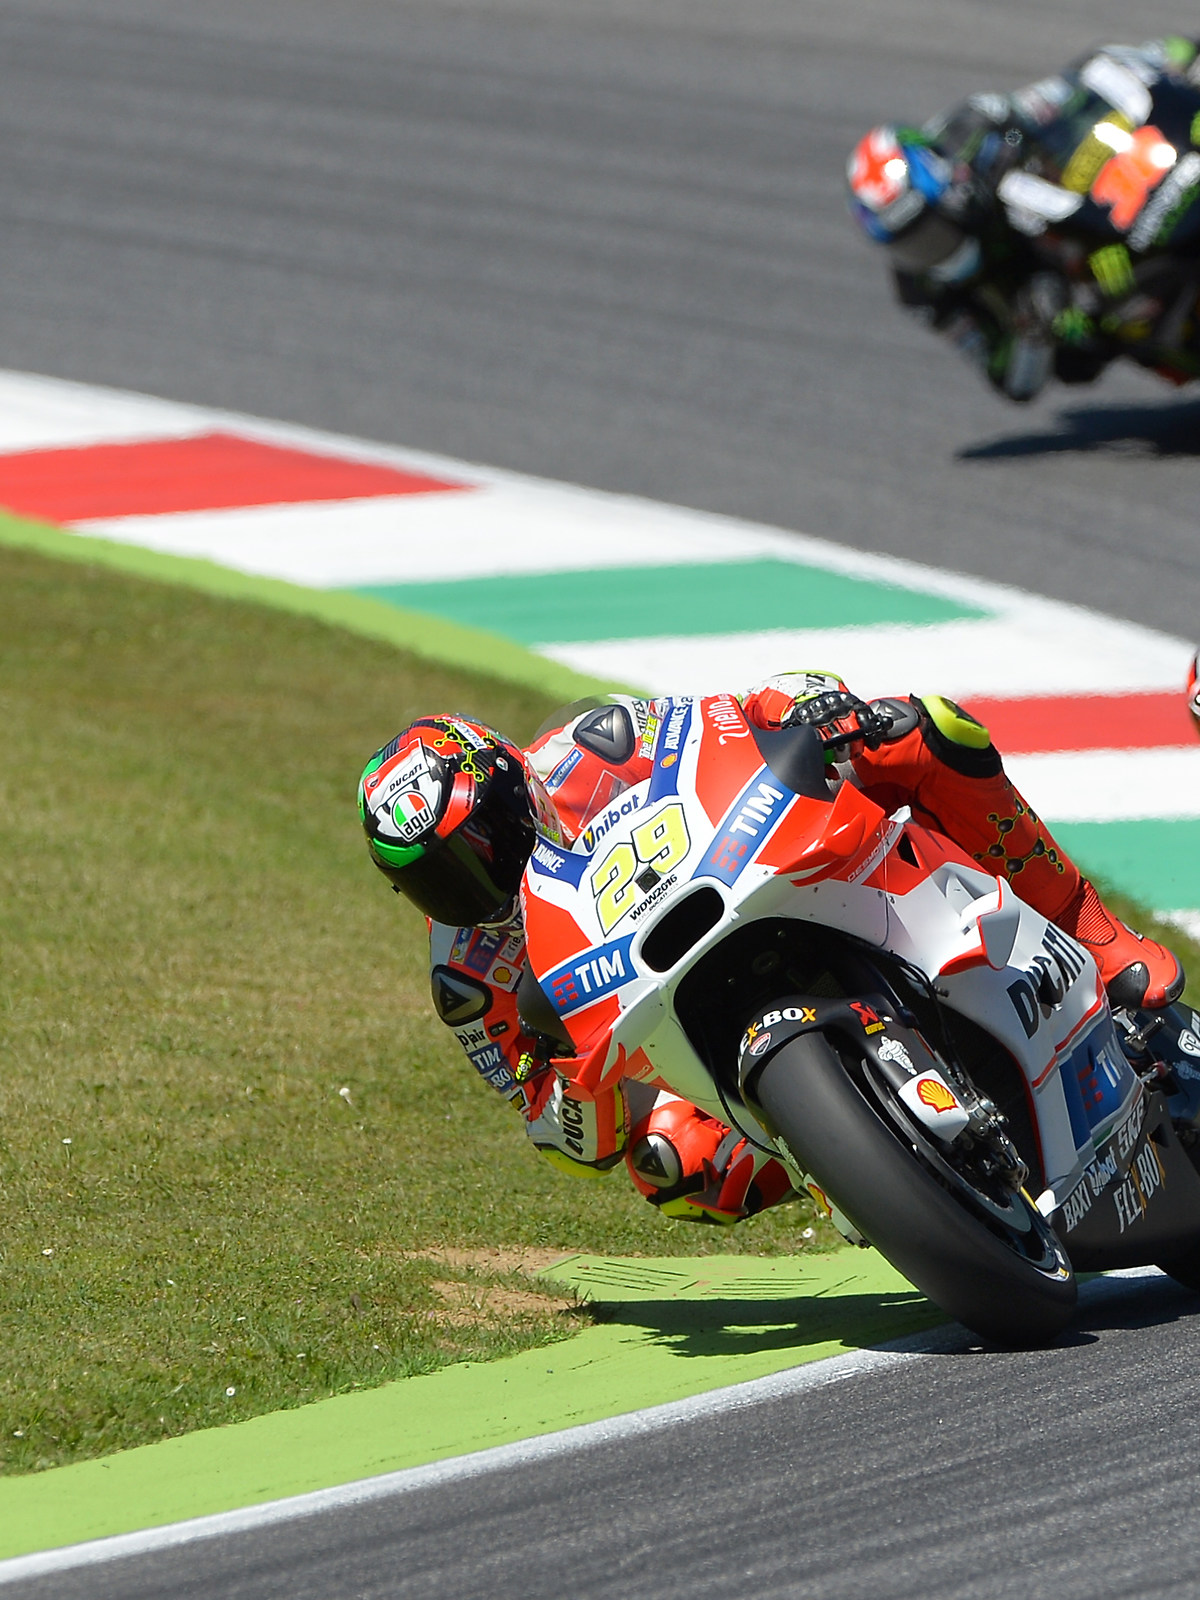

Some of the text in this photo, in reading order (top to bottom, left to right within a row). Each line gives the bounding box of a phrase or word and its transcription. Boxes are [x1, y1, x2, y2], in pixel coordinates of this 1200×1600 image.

[389, 762, 424, 793] DUCATI
[402, 808, 431, 837] agv
[581, 793, 640, 854] Unibat
[729, 782, 784, 837] TIM
[590, 802, 692, 938] 29
[629, 873, 678, 921] WDW2016
[574, 949, 626, 994] TIM
[472, 1047, 501, 1068] TIM
[1062, 1180, 1092, 1233] BAXI
[1117, 1095, 1146, 1160] SKF
